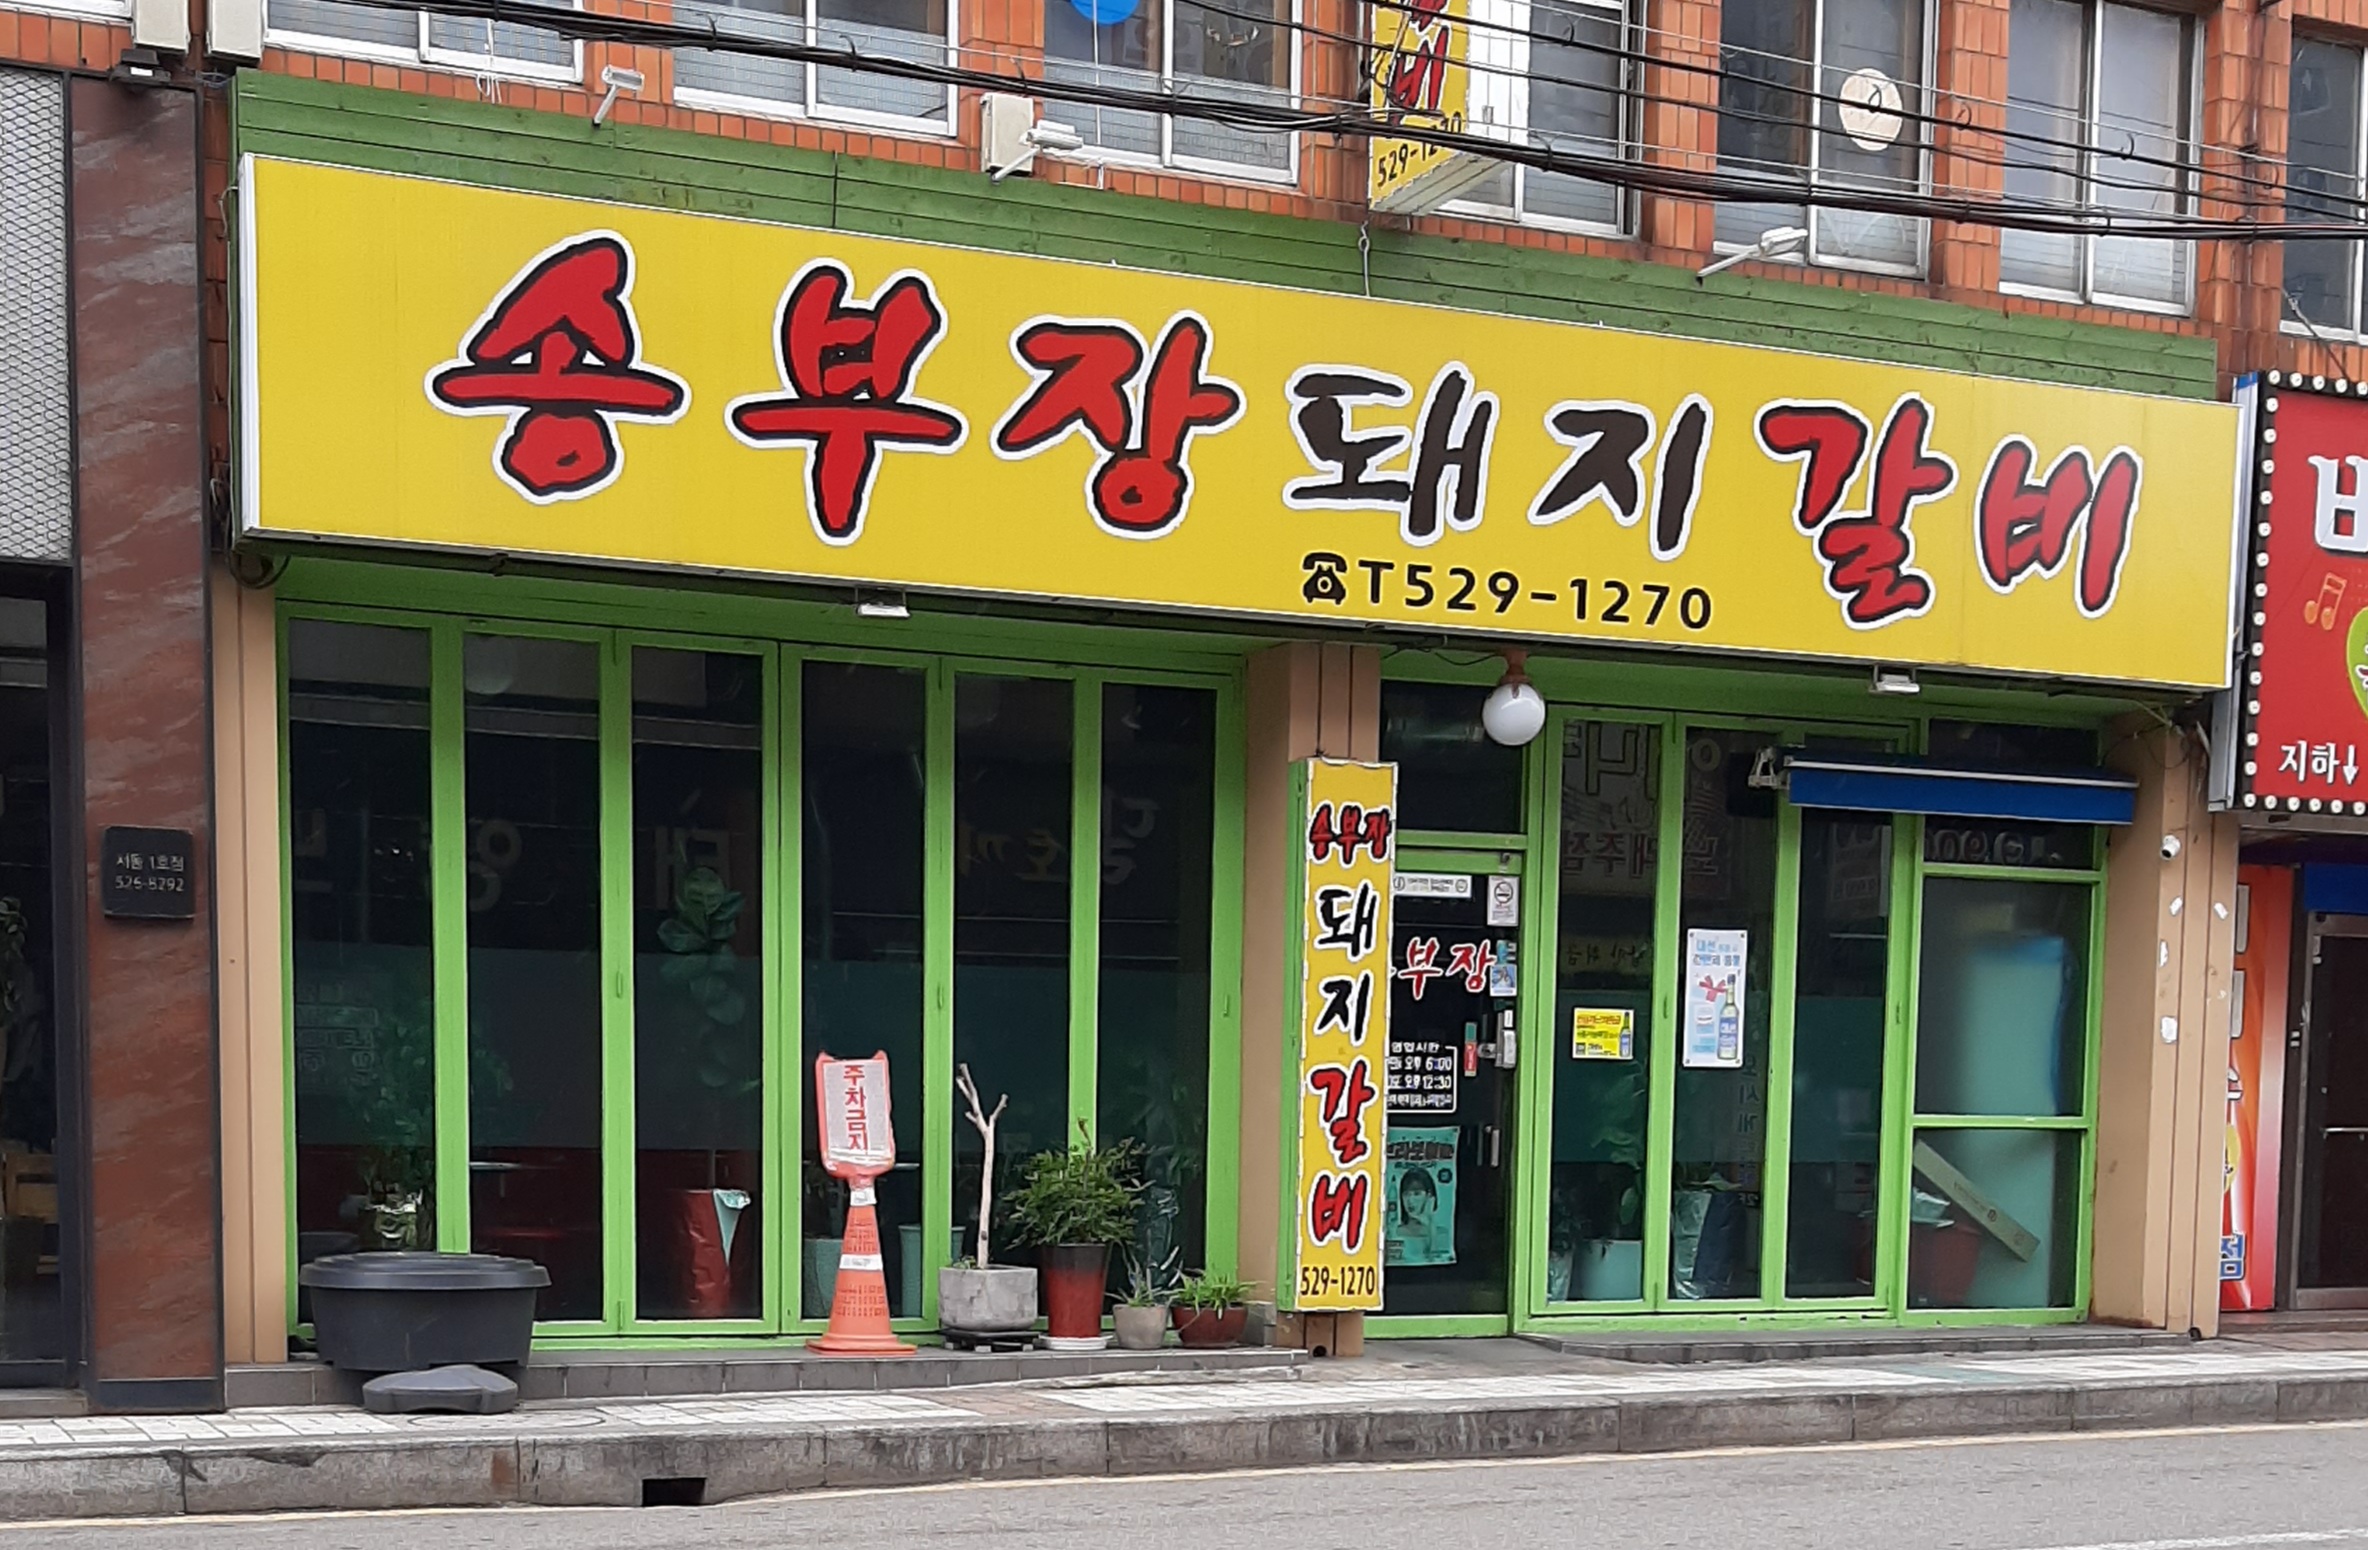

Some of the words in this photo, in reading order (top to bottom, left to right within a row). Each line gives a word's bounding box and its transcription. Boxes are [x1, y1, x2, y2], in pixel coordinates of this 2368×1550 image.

[430, 233, 1241, 541] 송부장
[2279, 740, 2341, 784] 지하
[1308, 802, 1392, 867] 송부장
[1391, 936, 1497, 1001] 부장
[843, 1064, 868, 1151] 주차금지
[1301, 1266, 1376, 1296] 529-1270
